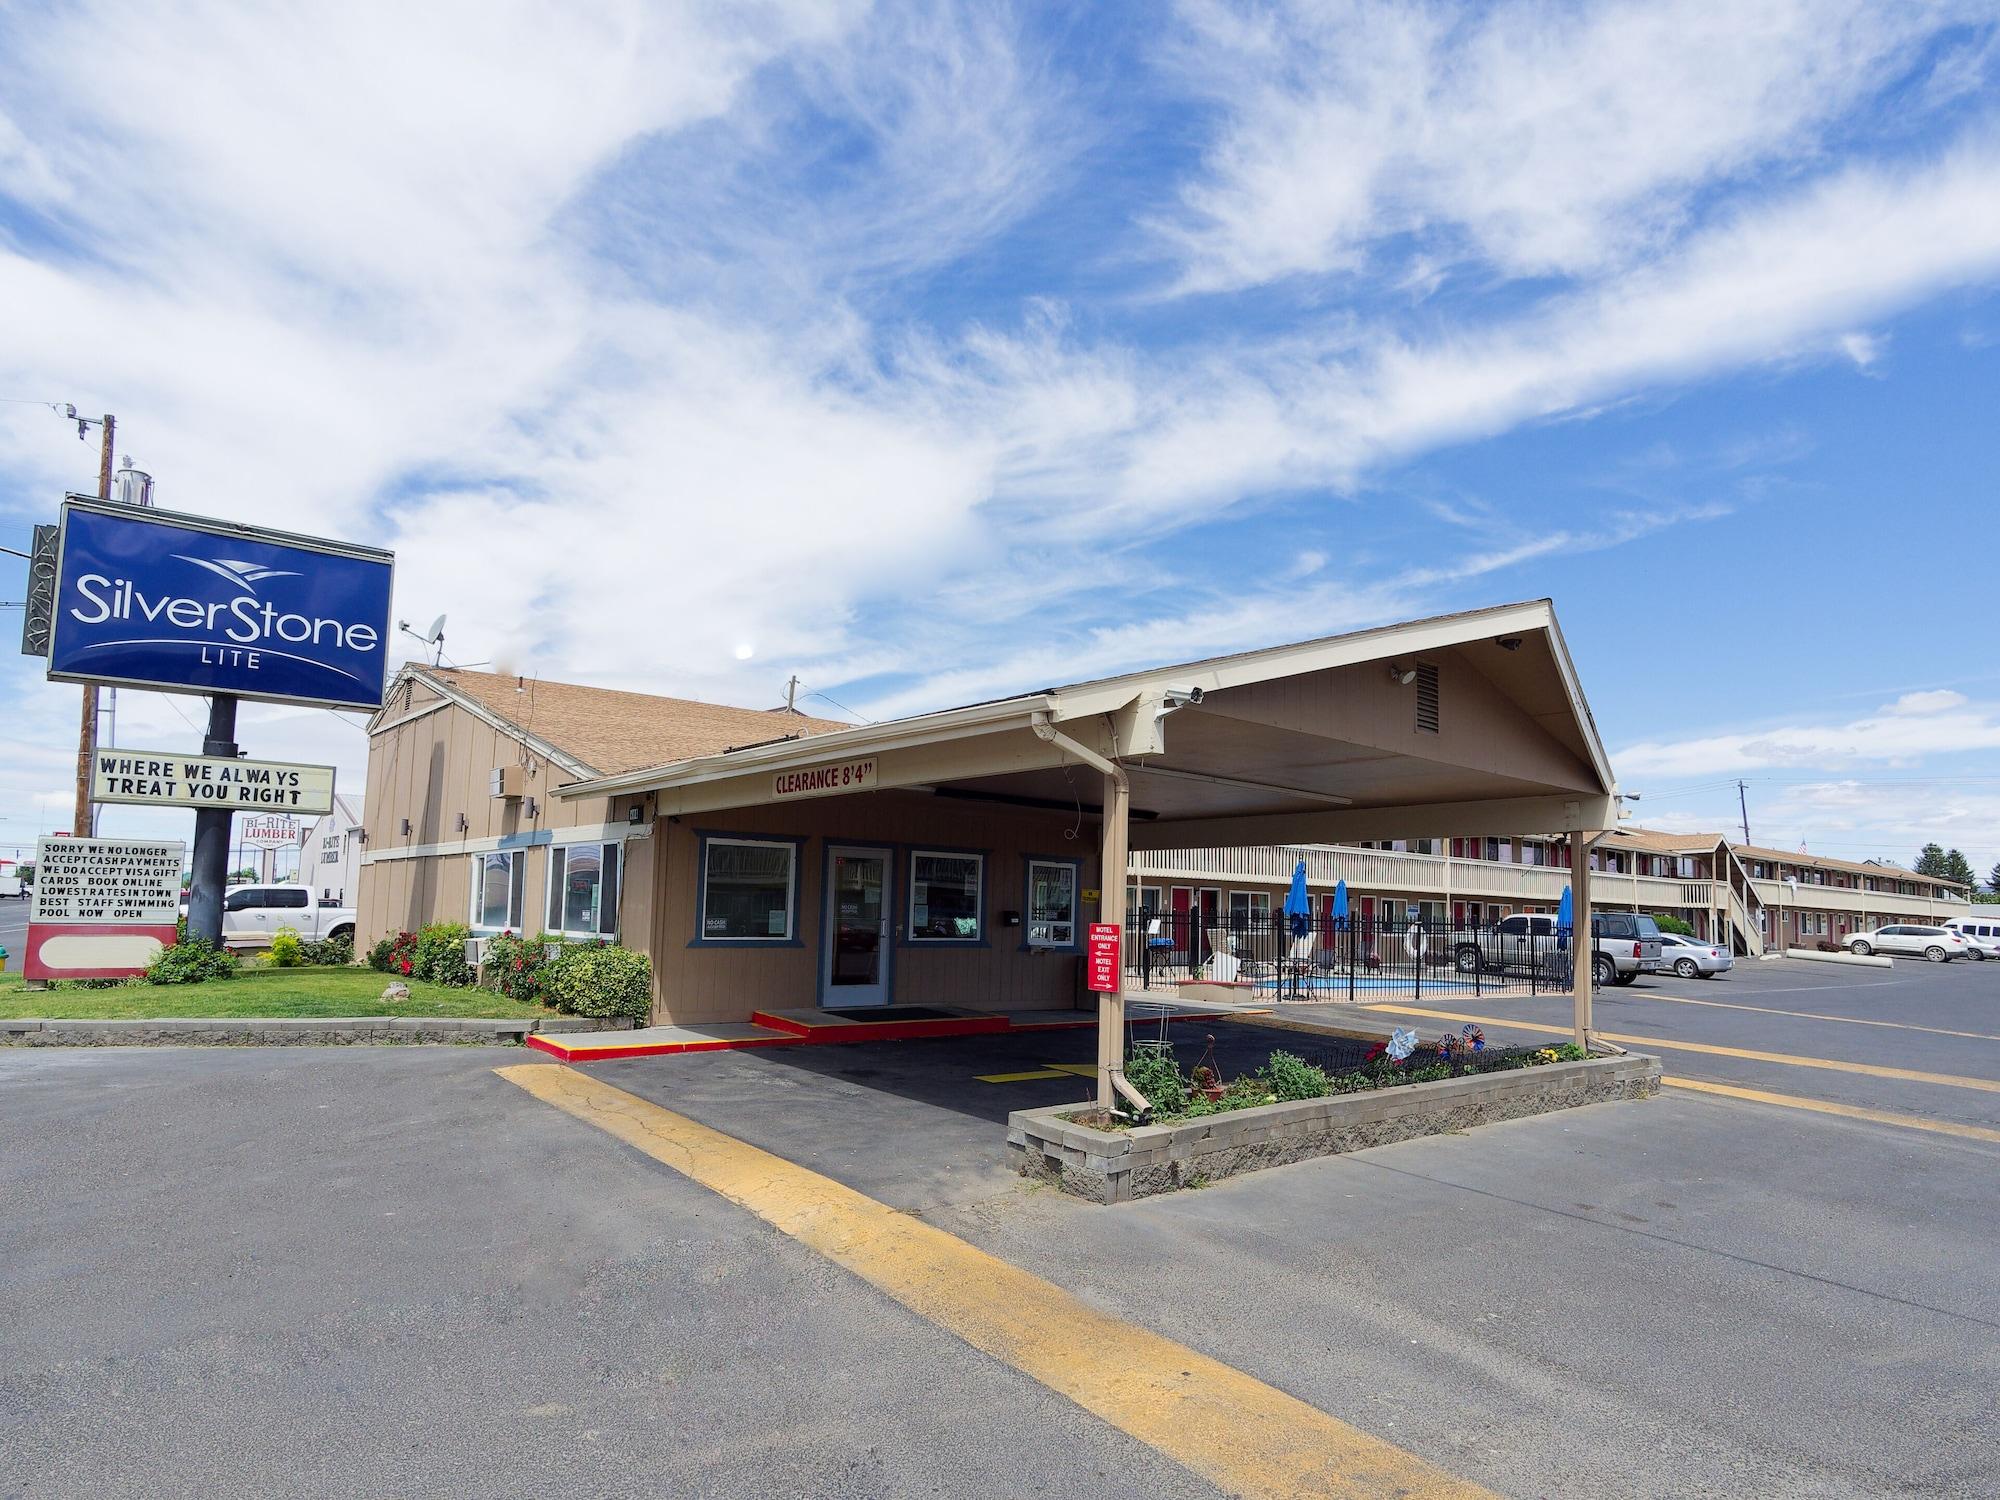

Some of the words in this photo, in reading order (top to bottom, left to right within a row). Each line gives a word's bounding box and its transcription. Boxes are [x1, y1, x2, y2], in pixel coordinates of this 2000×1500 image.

[70, 573, 378, 651] SilverStone
[201, 646, 260, 670] LITE
[100, 757, 174, 778] WHERE
[184, 764, 212, 780] WE
[219, 767, 299, 787] ALWAYS
[776, 768, 839, 794] CLEARANCE
[107, 777, 177, 797] TREAT
[188, 784, 228, 800] YOU
[239, 786, 302, 805] RIGHT
[246, 817, 296, 830] BI-RITE
[245, 828, 295, 839] LUMBER
[45, 844, 84, 853] SORRY
[88, 845, 104, 854] WE
[107, 846, 122, 855] NO
[125, 847, 167, 857] LONGER
[44, 855, 88, 864] ACCEPT
[89, 856, 118, 865] CASH
[120, 857, 180, 867] PAYMENTS
[43, 865, 60, 874] WE
[63, 866, 78, 875] DO
[80, 867, 123, 876] ACCEPT
[125, 868, 150, 877] VISA
[153, 869, 178, 877] GIFT
[40, 876, 79, 885] CARDS
[88, 877, 118, 886] BOOK
[122, 878, 163, 887] ONLINE
[41, 887, 88, 896] LOWEST
[90, 888, 126, 897] RATES
[141, 889, 172, 898] TOWN
[39, 898, 70, 906] BEST
[77, 898, 114, 907] STAFF
[117, 899, 175, 908] SWIMMING
[39, 908, 70, 917] POOL
[78, 909, 105, 917] NOW
[113, 910, 142, 918] OPEN
[1091, 934, 1118, 942] ENTRANCE
[1096, 974, 1110, 982] ONLY
